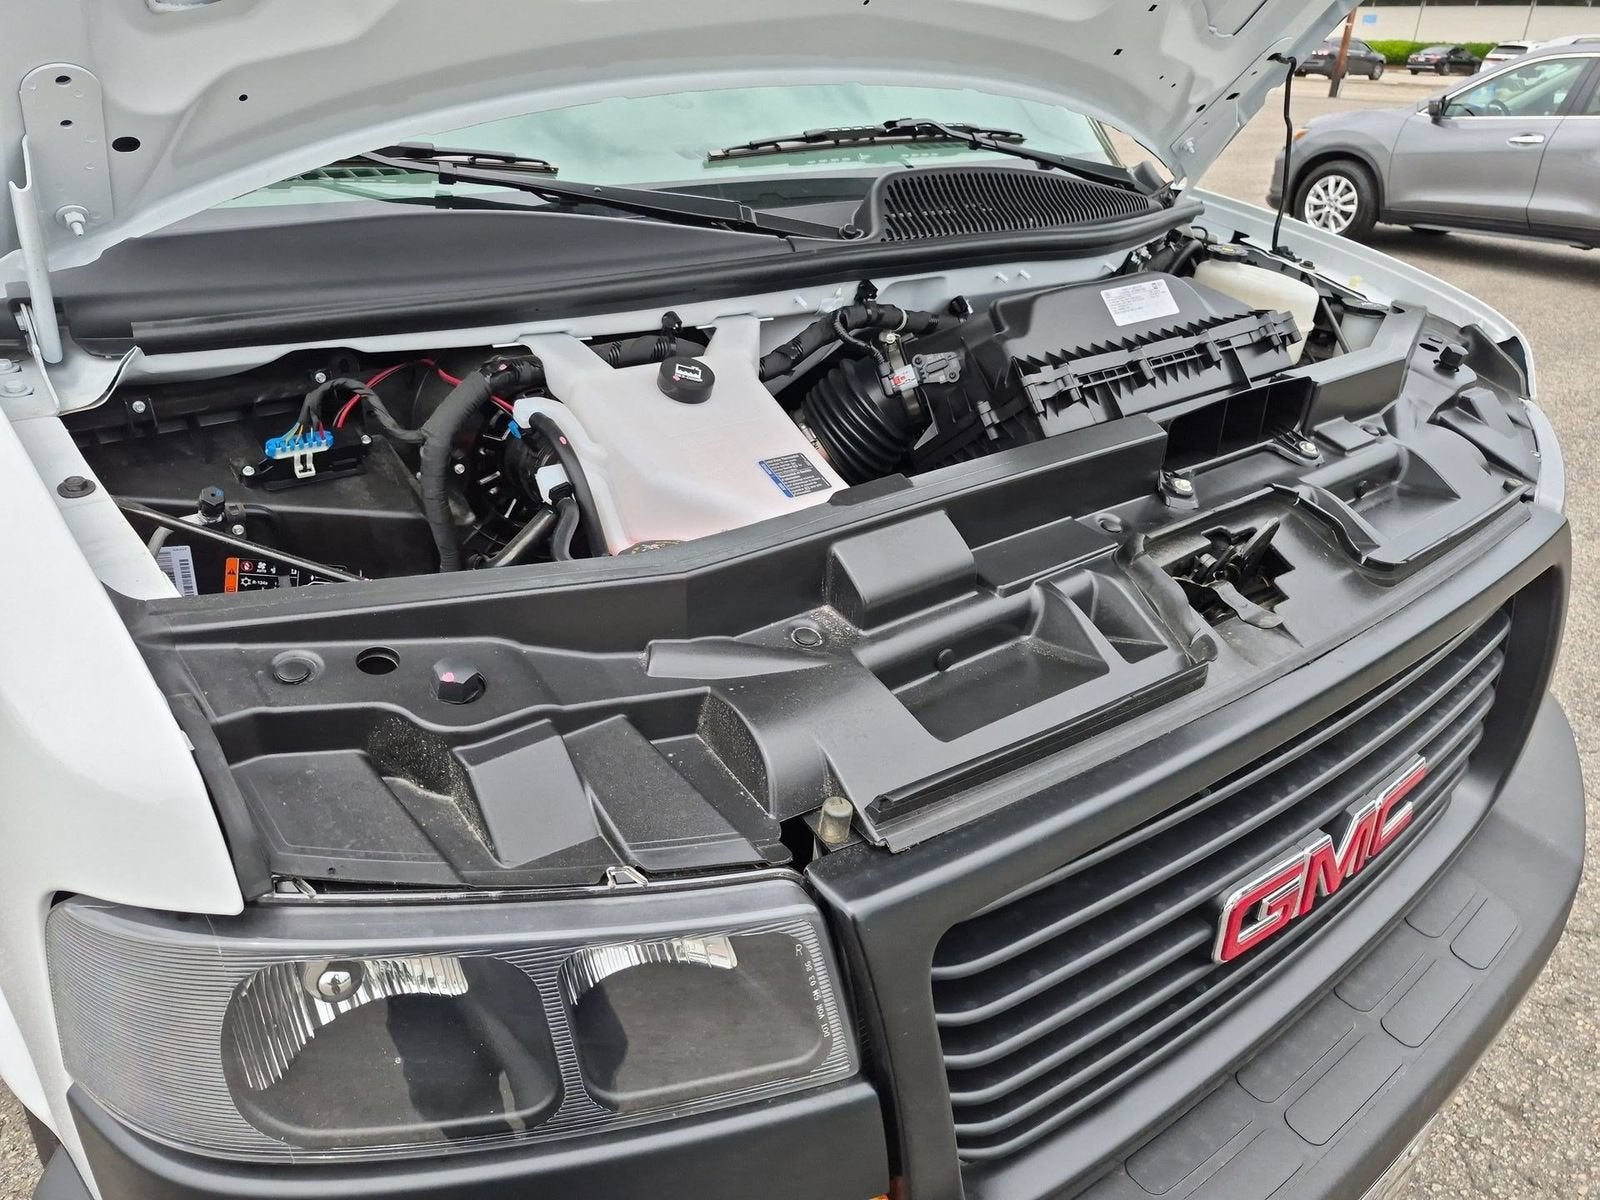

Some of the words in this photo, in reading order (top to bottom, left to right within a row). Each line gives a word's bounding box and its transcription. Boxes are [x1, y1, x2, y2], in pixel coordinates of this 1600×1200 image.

[1211, 755, 1427, 964] GMC
[795, 944, 803, 956] R
[808, 975, 817, 987] 03
[821, 1023, 831, 1038] DOT
